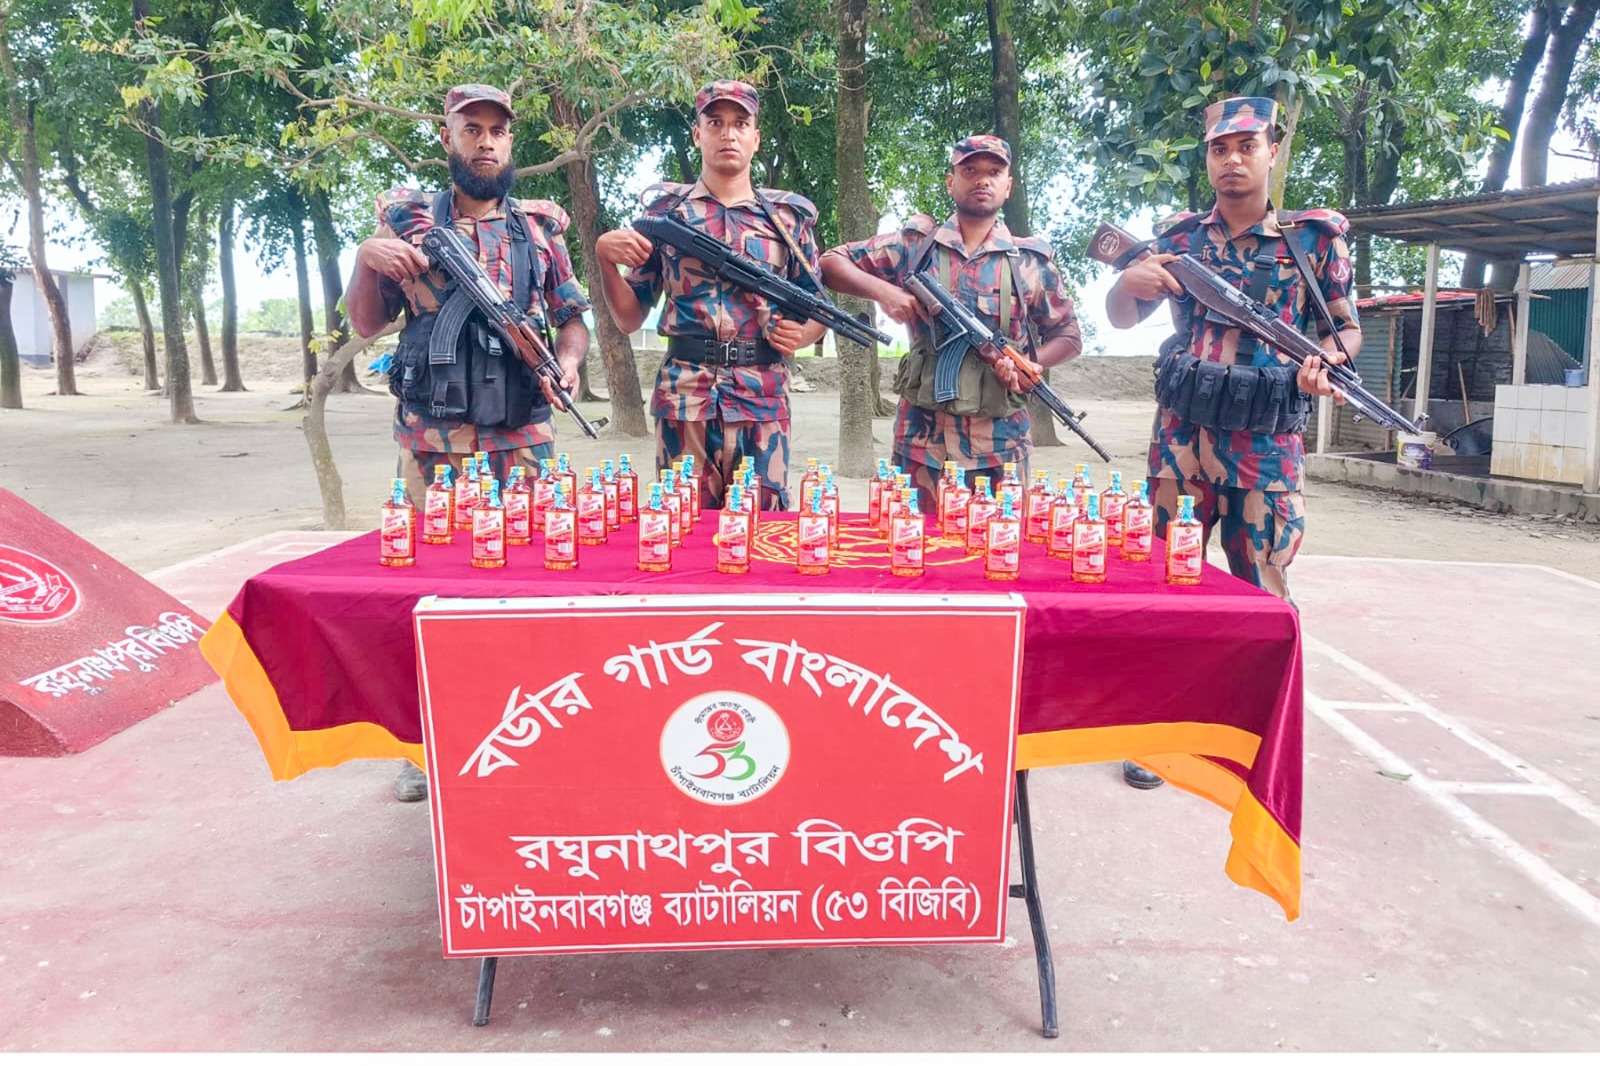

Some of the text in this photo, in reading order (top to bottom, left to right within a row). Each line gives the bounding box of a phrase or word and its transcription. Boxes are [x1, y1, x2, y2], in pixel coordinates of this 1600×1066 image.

[459, 622, 983, 783] বর্ডার গার্ড বাংলাদেশ
[670, 765, 735, 800] চাঁপাইনবাবগঞ্জ
[510, 818, 965, 880] রঘুনাথপুর বিওপি
[456, 877, 981, 932] চাঁপাইনবাবগঞ্জ ব্যাটালিয়ন (৫৩ বিজিবি)
